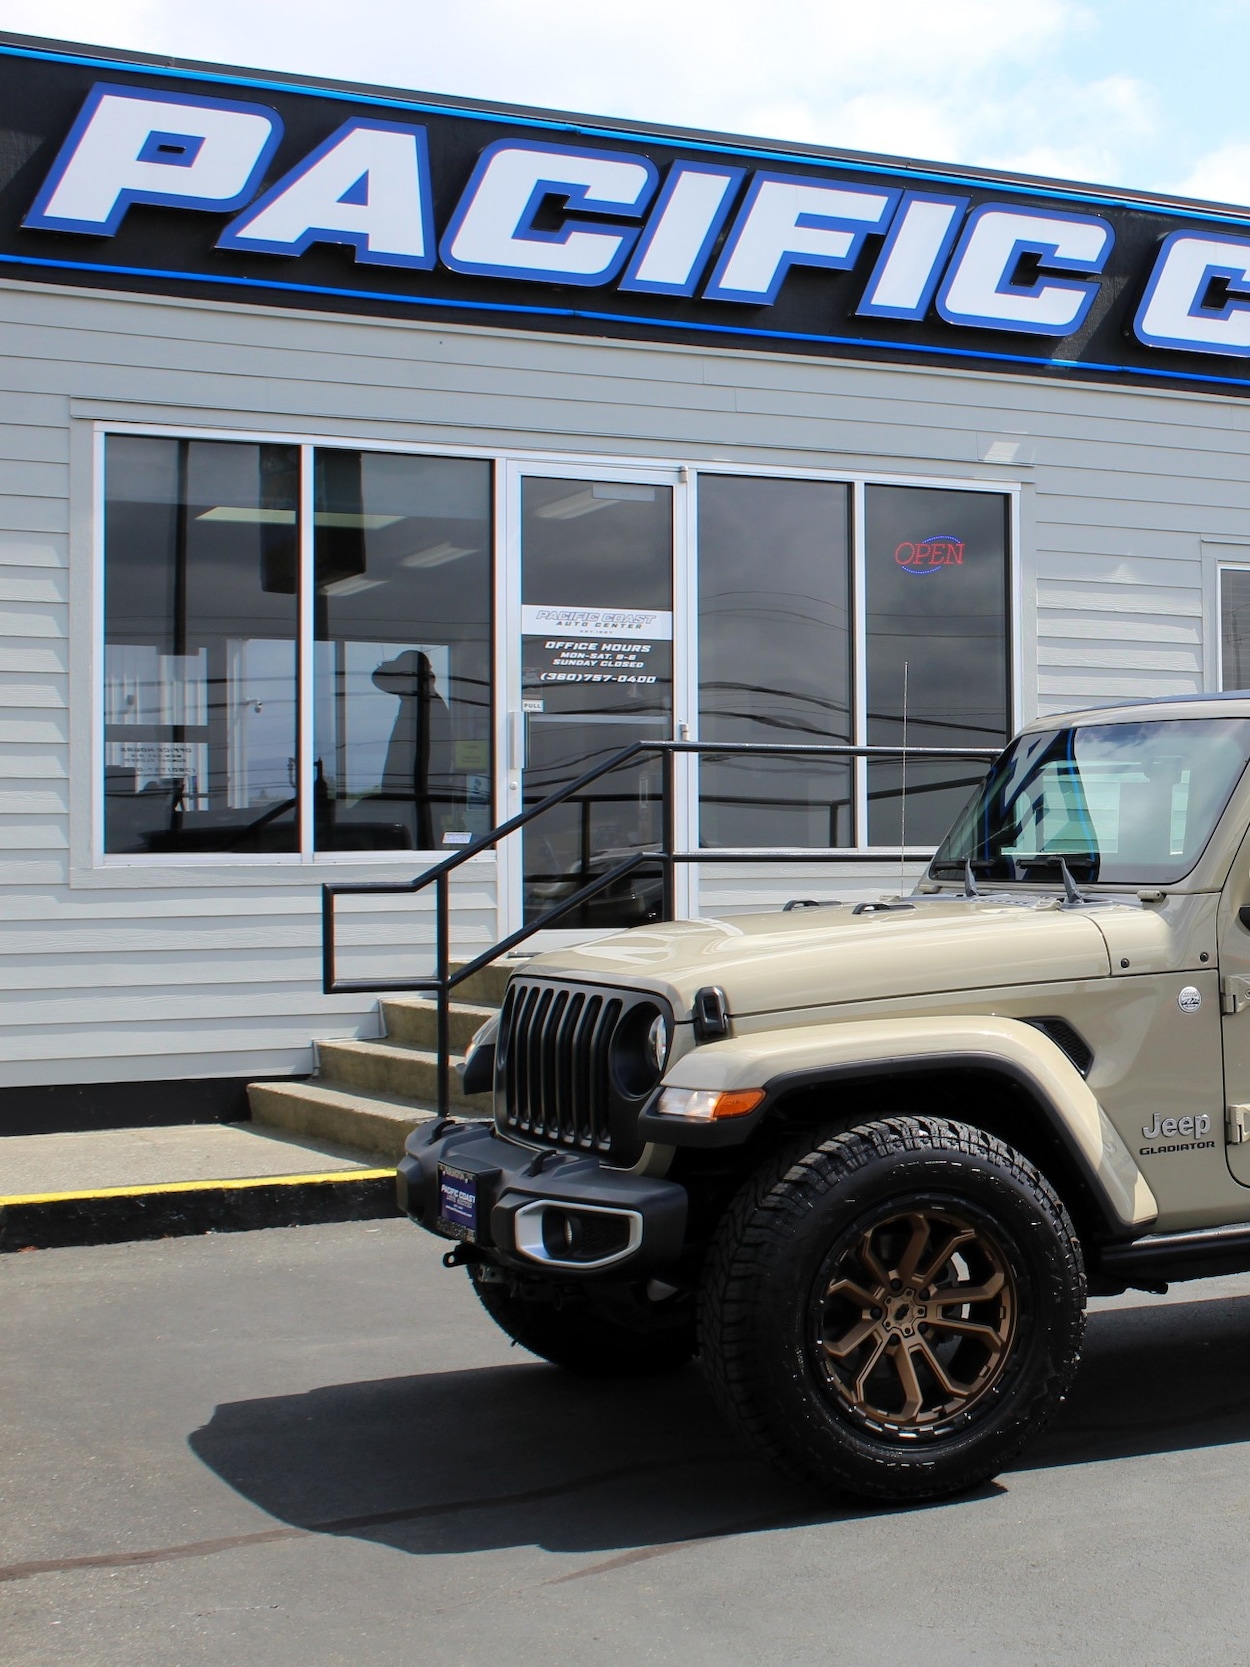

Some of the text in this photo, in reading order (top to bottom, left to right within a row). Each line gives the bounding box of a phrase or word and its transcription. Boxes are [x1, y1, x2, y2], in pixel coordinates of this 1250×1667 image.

[20, 82, 1115, 336] PACIFIC
[894, 542, 967, 565] OPEN
[536, 610, 657, 624] PACIFIC COAST
[545, 641, 652, 653] OFFICE HOURS
[560, 652, 613, 660] MON-SAT.
[552, 659, 644, 669] SUNDAY CLOSED
[540, 672, 657, 684] (360)757-0400
[1142, 1112, 1211, 1139] Jeep
[1140, 1141, 1215, 1155] GLADIATOR
